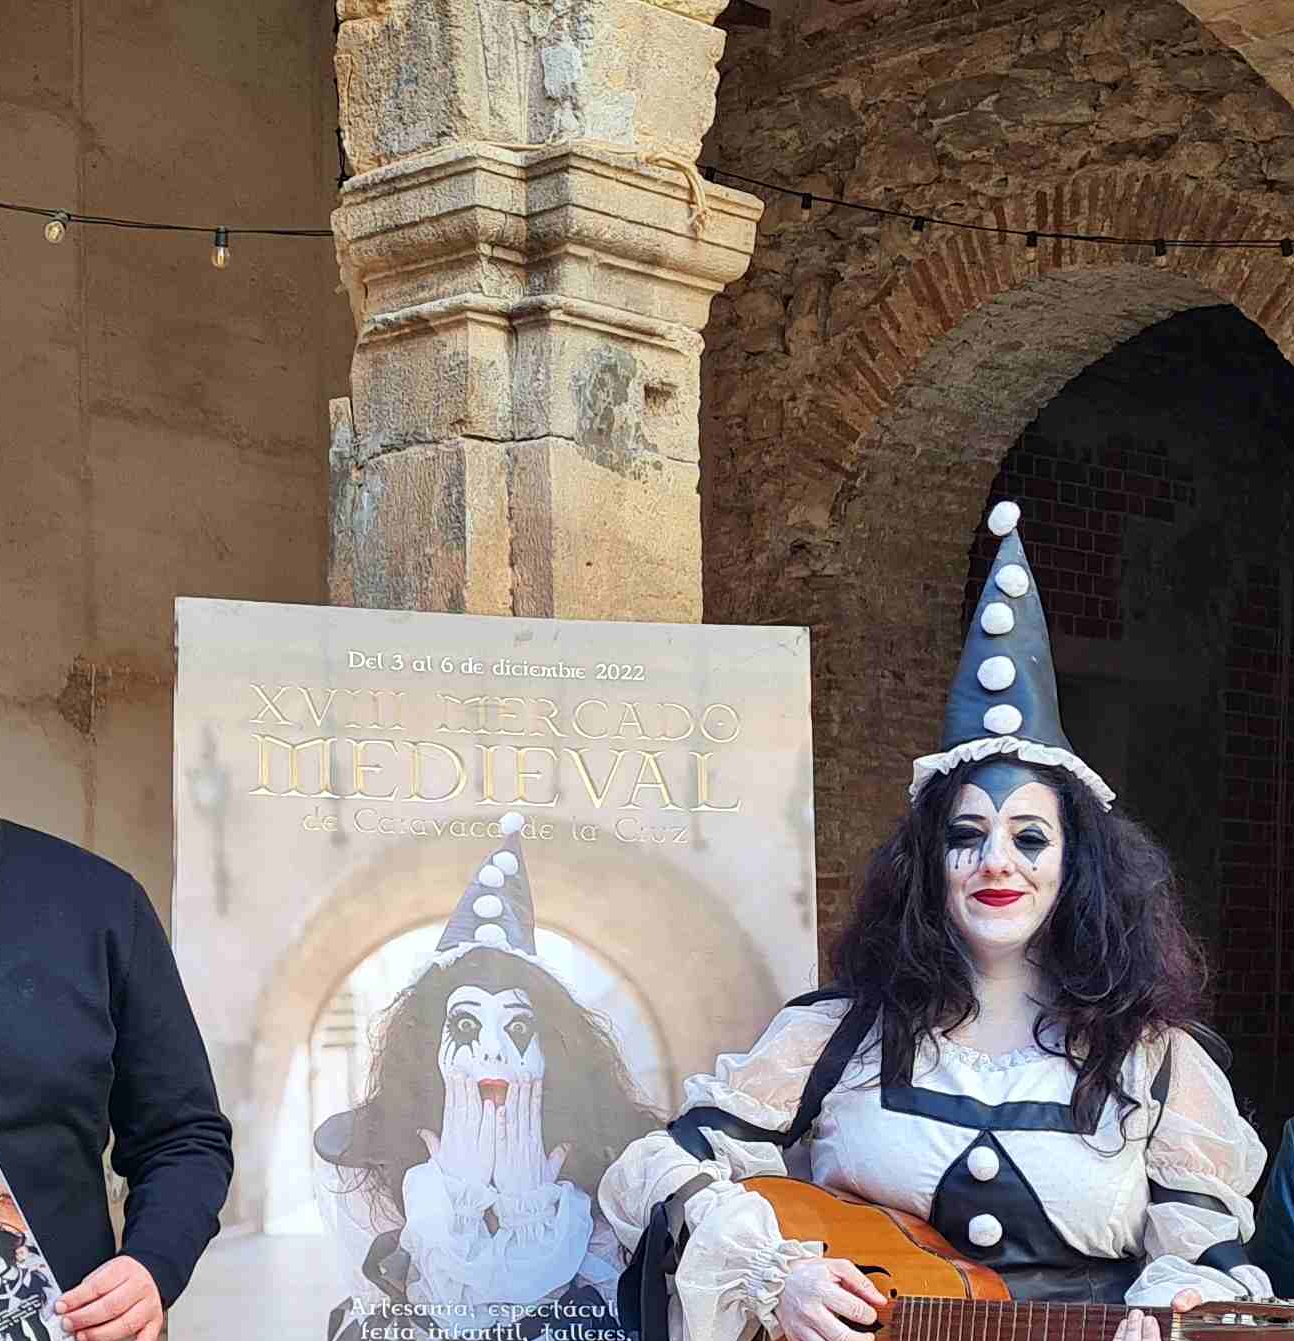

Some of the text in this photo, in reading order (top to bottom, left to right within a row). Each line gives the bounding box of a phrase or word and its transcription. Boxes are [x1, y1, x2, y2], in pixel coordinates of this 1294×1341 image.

[348, 650, 646, 681] Del 3 al 6 de diciembre 2022
[435, 690, 741, 744] MERCADO
[248, 733, 743, 813] MEDIEVAL
[303, 806, 338, 832] de
[520, 815, 554, 841] de
[571, 815, 600, 841] la
[488, 1299, 618, 1322] espectácul
[360, 1321, 416, 1341] feria
